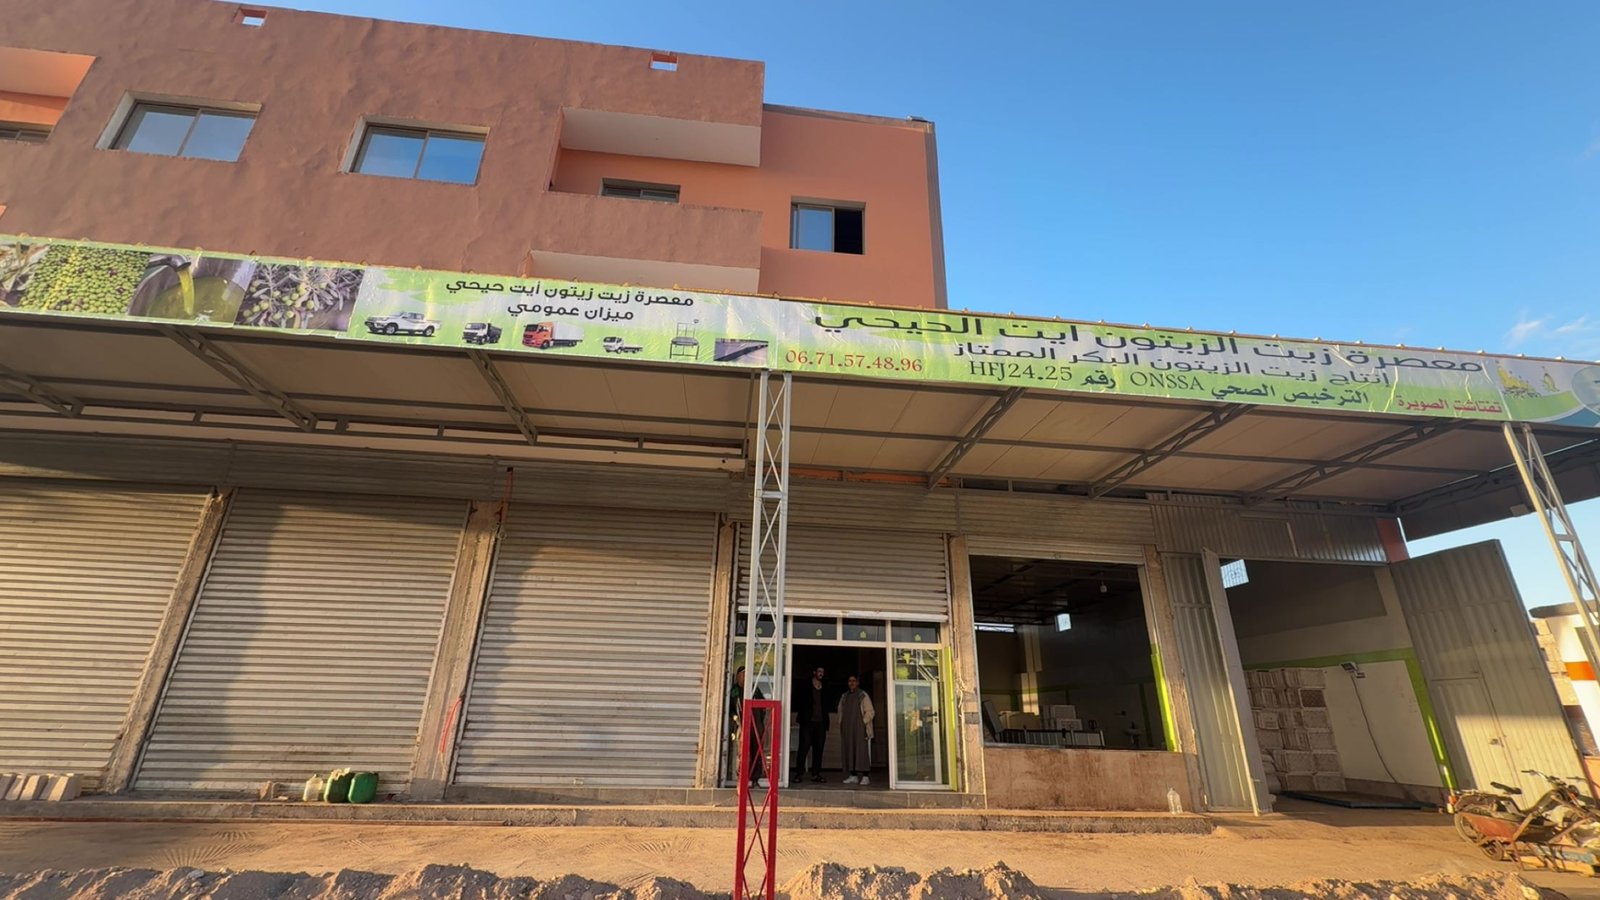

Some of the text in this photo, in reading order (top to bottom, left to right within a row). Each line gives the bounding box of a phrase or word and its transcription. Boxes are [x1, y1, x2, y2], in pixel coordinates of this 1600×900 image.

[446, 278, 694, 307] معصرة زيت زيتون أيت حيحي
[507, 302, 634, 322] ميزان عمومي
[815, 315, 1482, 372] معصرة زيت الزيتون ايت الحيحي
[785, 349, 923, 373] 06.71.57.48.96
[954, 341, 1390, 388] إنتاج زيت الزيتون البكر الممتاز
[969, 360, 1369, 406] الترخيص الصحي ONSSA رقم HFJ24.25
[1395, 394, 1449, 411] الصويرة
